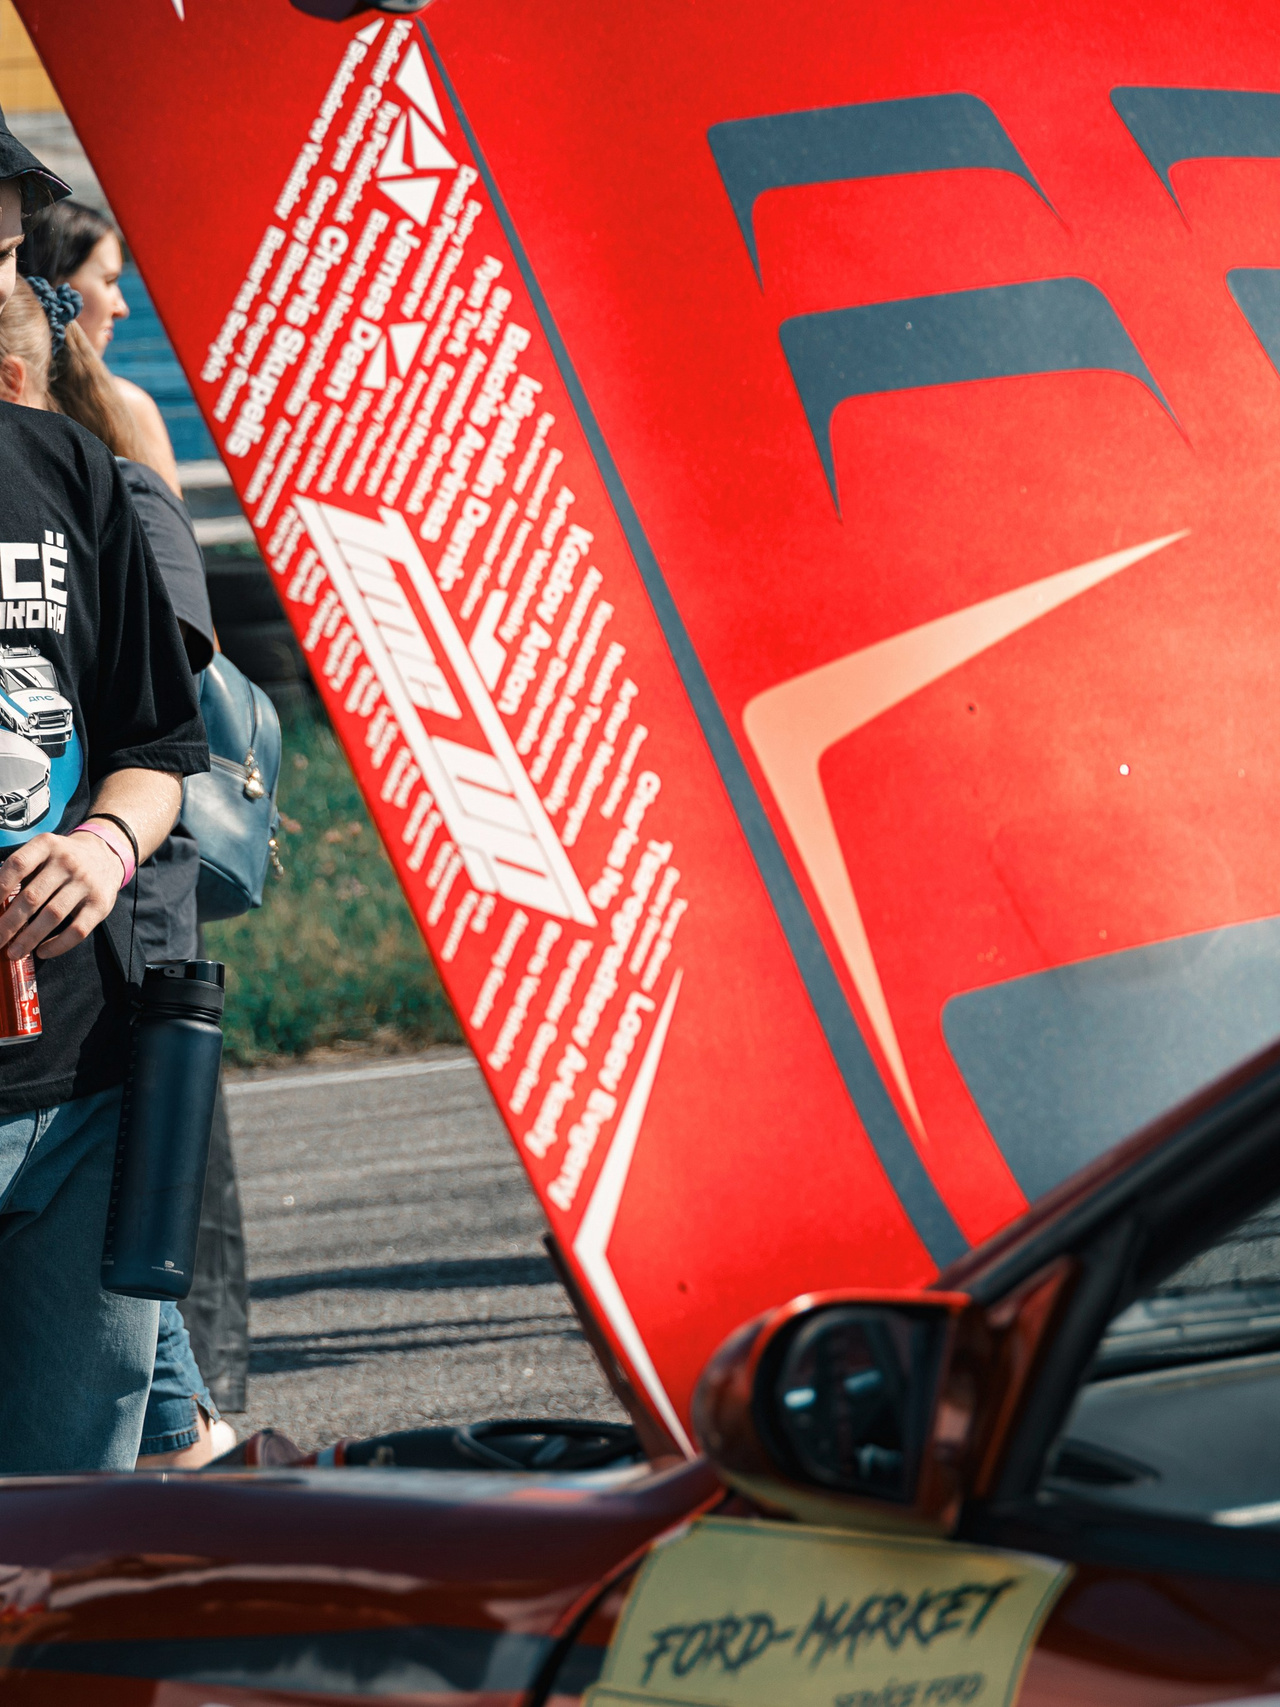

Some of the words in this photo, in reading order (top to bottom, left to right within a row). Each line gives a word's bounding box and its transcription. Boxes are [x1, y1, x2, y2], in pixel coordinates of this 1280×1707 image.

[371, 19, 413, 88] Vladimir
[372, 100, 401, 138] Ilya
[275, 142, 323, 221] Vladislav
[293, 175, 338, 246] Georgy
[334, 130, 388, 224] Polishchuk
[443, 164, 478, 218] Denis
[233, 225, 286, 316] Ekaterina
[285, 225, 349, 327] Charis
[337, 209, 390, 299] Ekaterina
[361, 219, 421, 321] James
[466, 255, 503, 309] Ryan
[234, 303, 277, 372] Grigory
[324, 317, 382, 402] Dean
[446, 309, 482, 358] Turk
[469, 322, 531, 427] Bakchis
[226, 324, 306, 458] Skupelis
[414, 361, 456, 430] Eduard
[441, 348, 488, 437] Alexander
[471, 374, 543, 499] Idiyatulin
[420, 423, 486, 543] Aurimas
[541, 486, 575, 550] Arthur
[436, 495, 492, 592] Damir
[536, 524, 594, 625] Kozlov
[497, 620, 552, 715] Anton
[604, 678, 639, 745] Arthur
[607, 771, 661, 869] Charles
[588, 866, 624, 909] Ng
[527, 920, 562, 976] Boris
[598, 991, 656, 1092] Losev
[524, 1044, 588, 1158] Arkady
[547, 1088, 617, 1210] Evgeny
[640, 1578, 1018, 1687] FORD-MARKET
